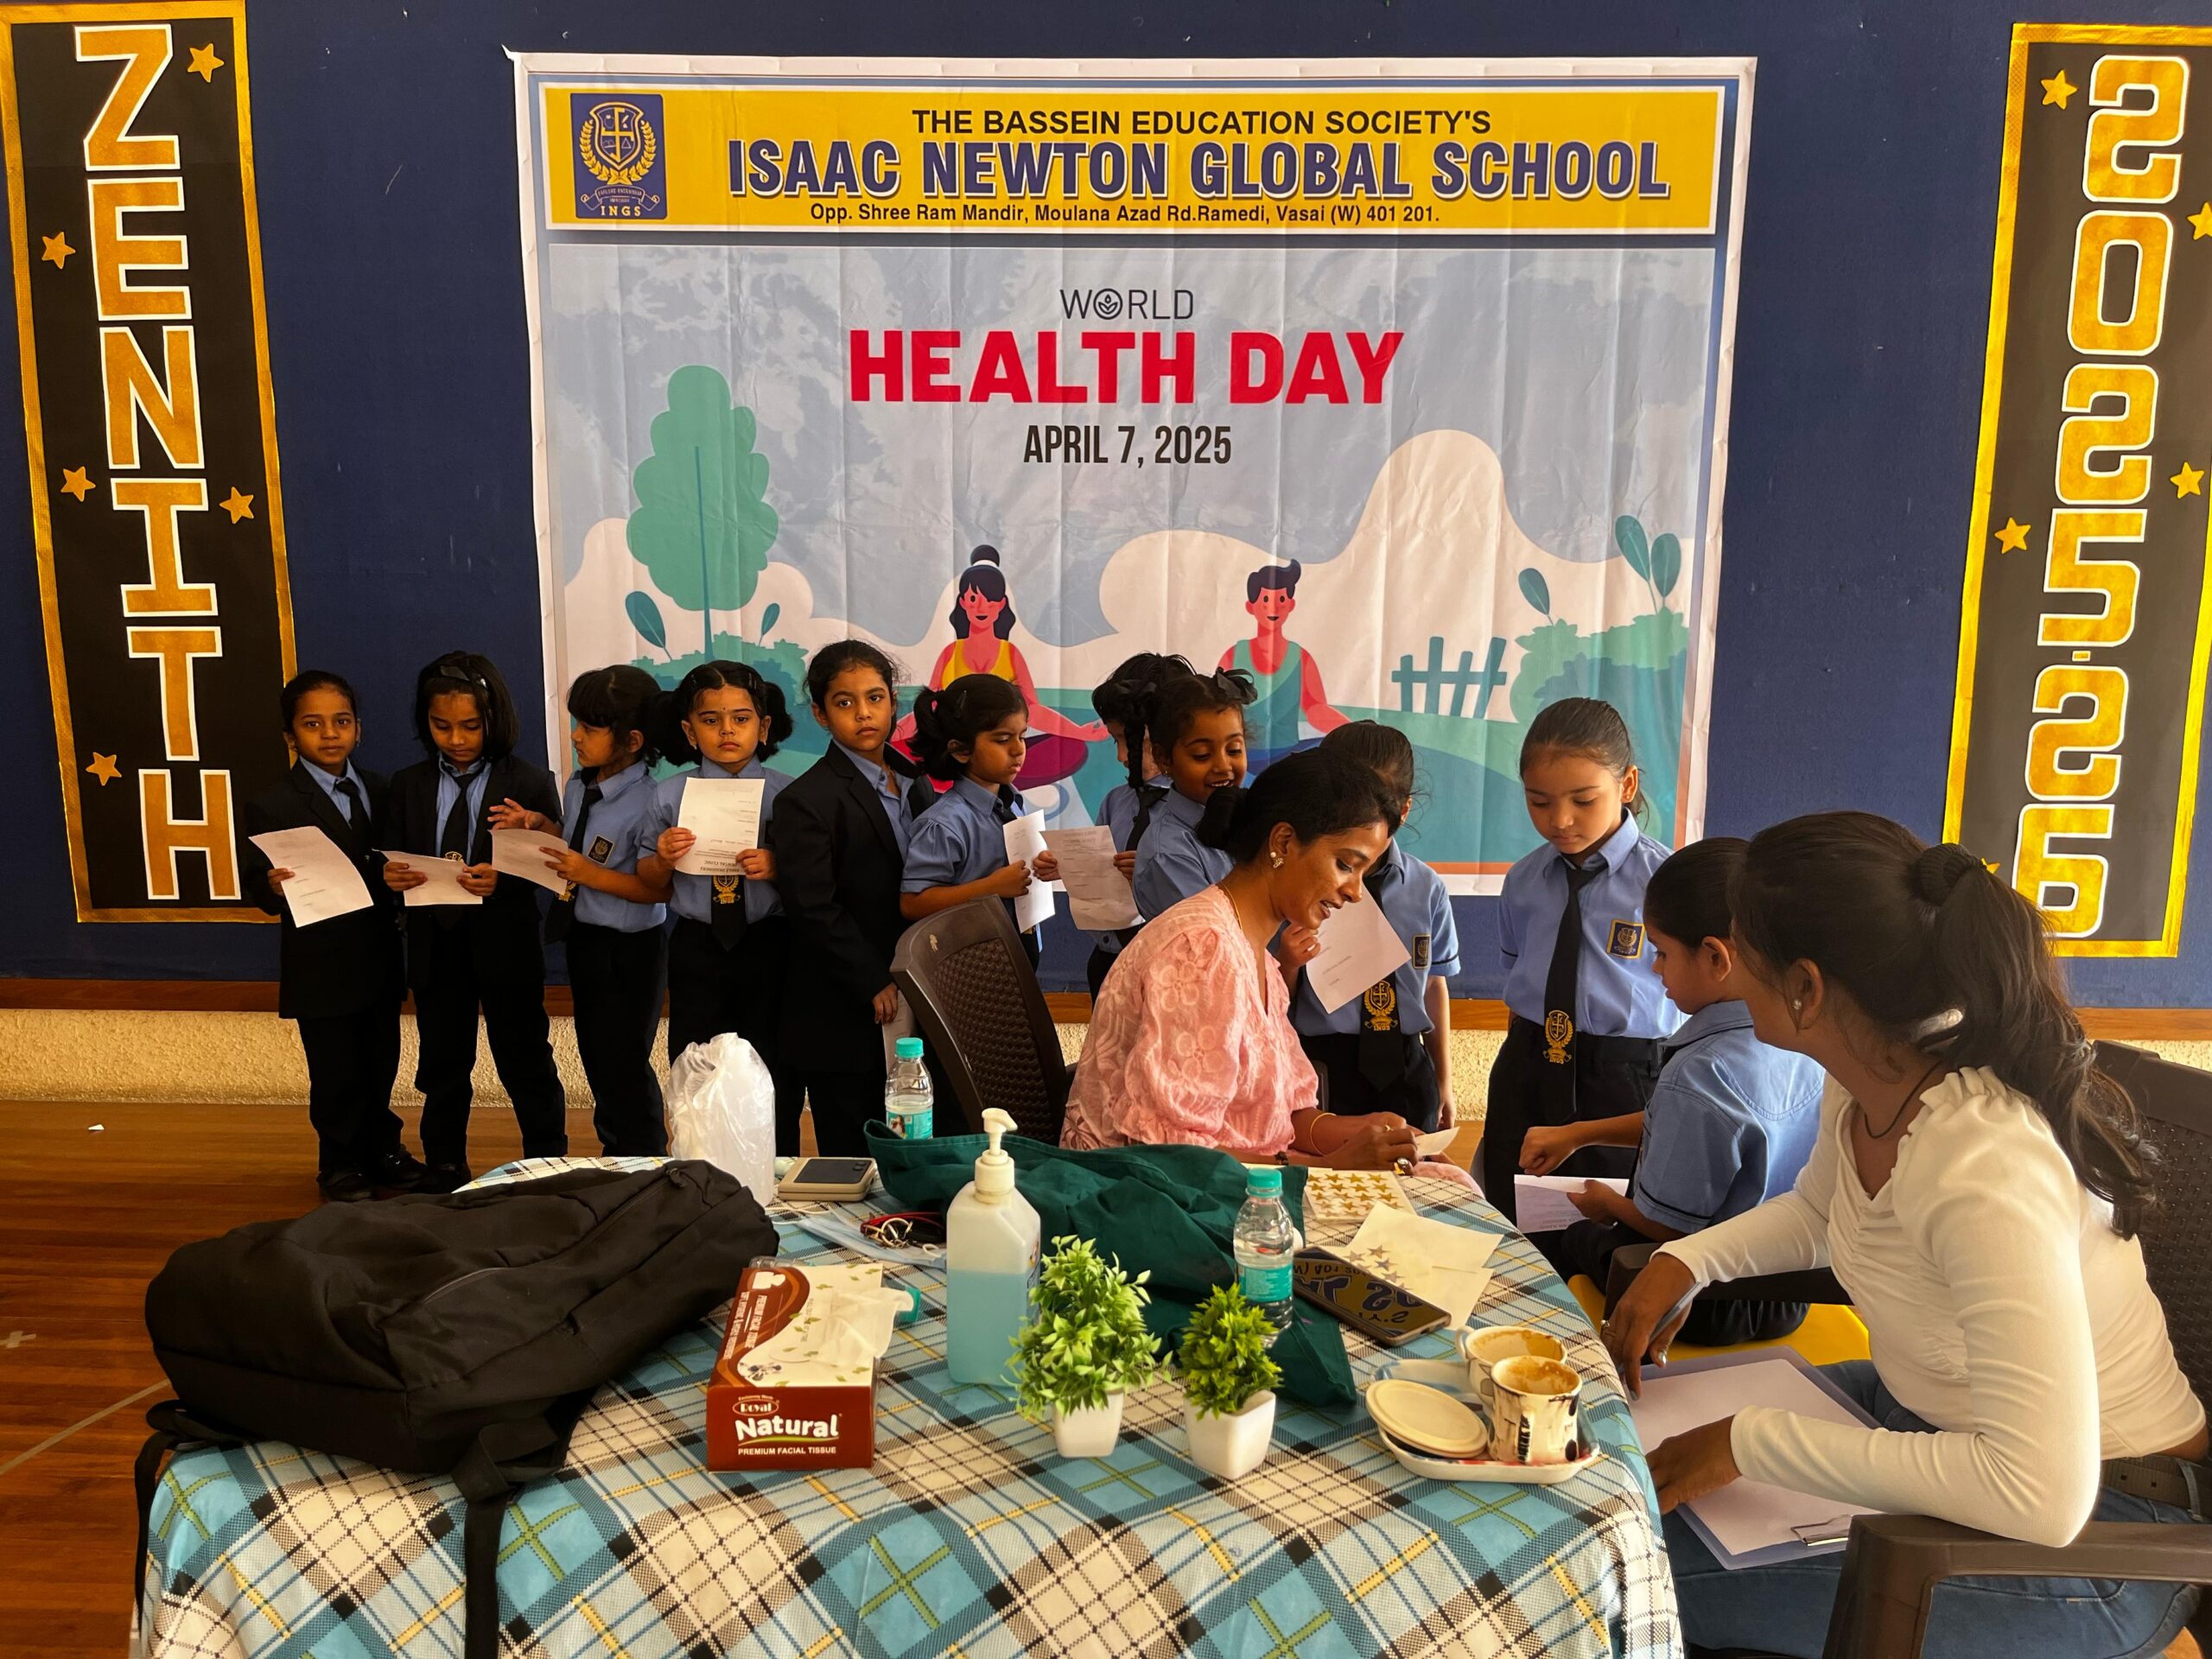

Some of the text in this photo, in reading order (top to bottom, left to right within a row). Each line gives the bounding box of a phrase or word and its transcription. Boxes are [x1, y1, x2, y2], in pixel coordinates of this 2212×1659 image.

[912, 110, 1491, 136] THE BASSEIN EDUCATION SOCIETY'S
[728, 138, 1671, 201] ISAAC NEWTON GLOBAL SCHOOL
[601, 206, 641, 217] INGS
[810, 204, 853, 223] Opp.
[859, 203, 911, 221] Shree
[917, 204, 957, 221] Ram
[963, 204, 1029, 225] Mandir,
[1035, 204, 1110, 223] Moulana
[1116, 204, 1161, 223] Azad
[1275, 205, 1325, 223] Vasai
[1330, 205, 1361, 226] (W)
[1366, 206, 1397, 223] 401
[1403, 206, 1440, 223] 201.
[1059, 288, 1195, 321] WORLD
[849, 329, 1405, 404] HEALTH DAY
[1023, 424, 1232, 468] APRIL 7, 2025
[73, 23, 243, 902] ZENITH
[740, 1402, 772, 1413] Royal
[734, 1414, 839, 1441] Natural
[738, 1445, 837, 1456] PREMIUM FACIAL TISSUE
